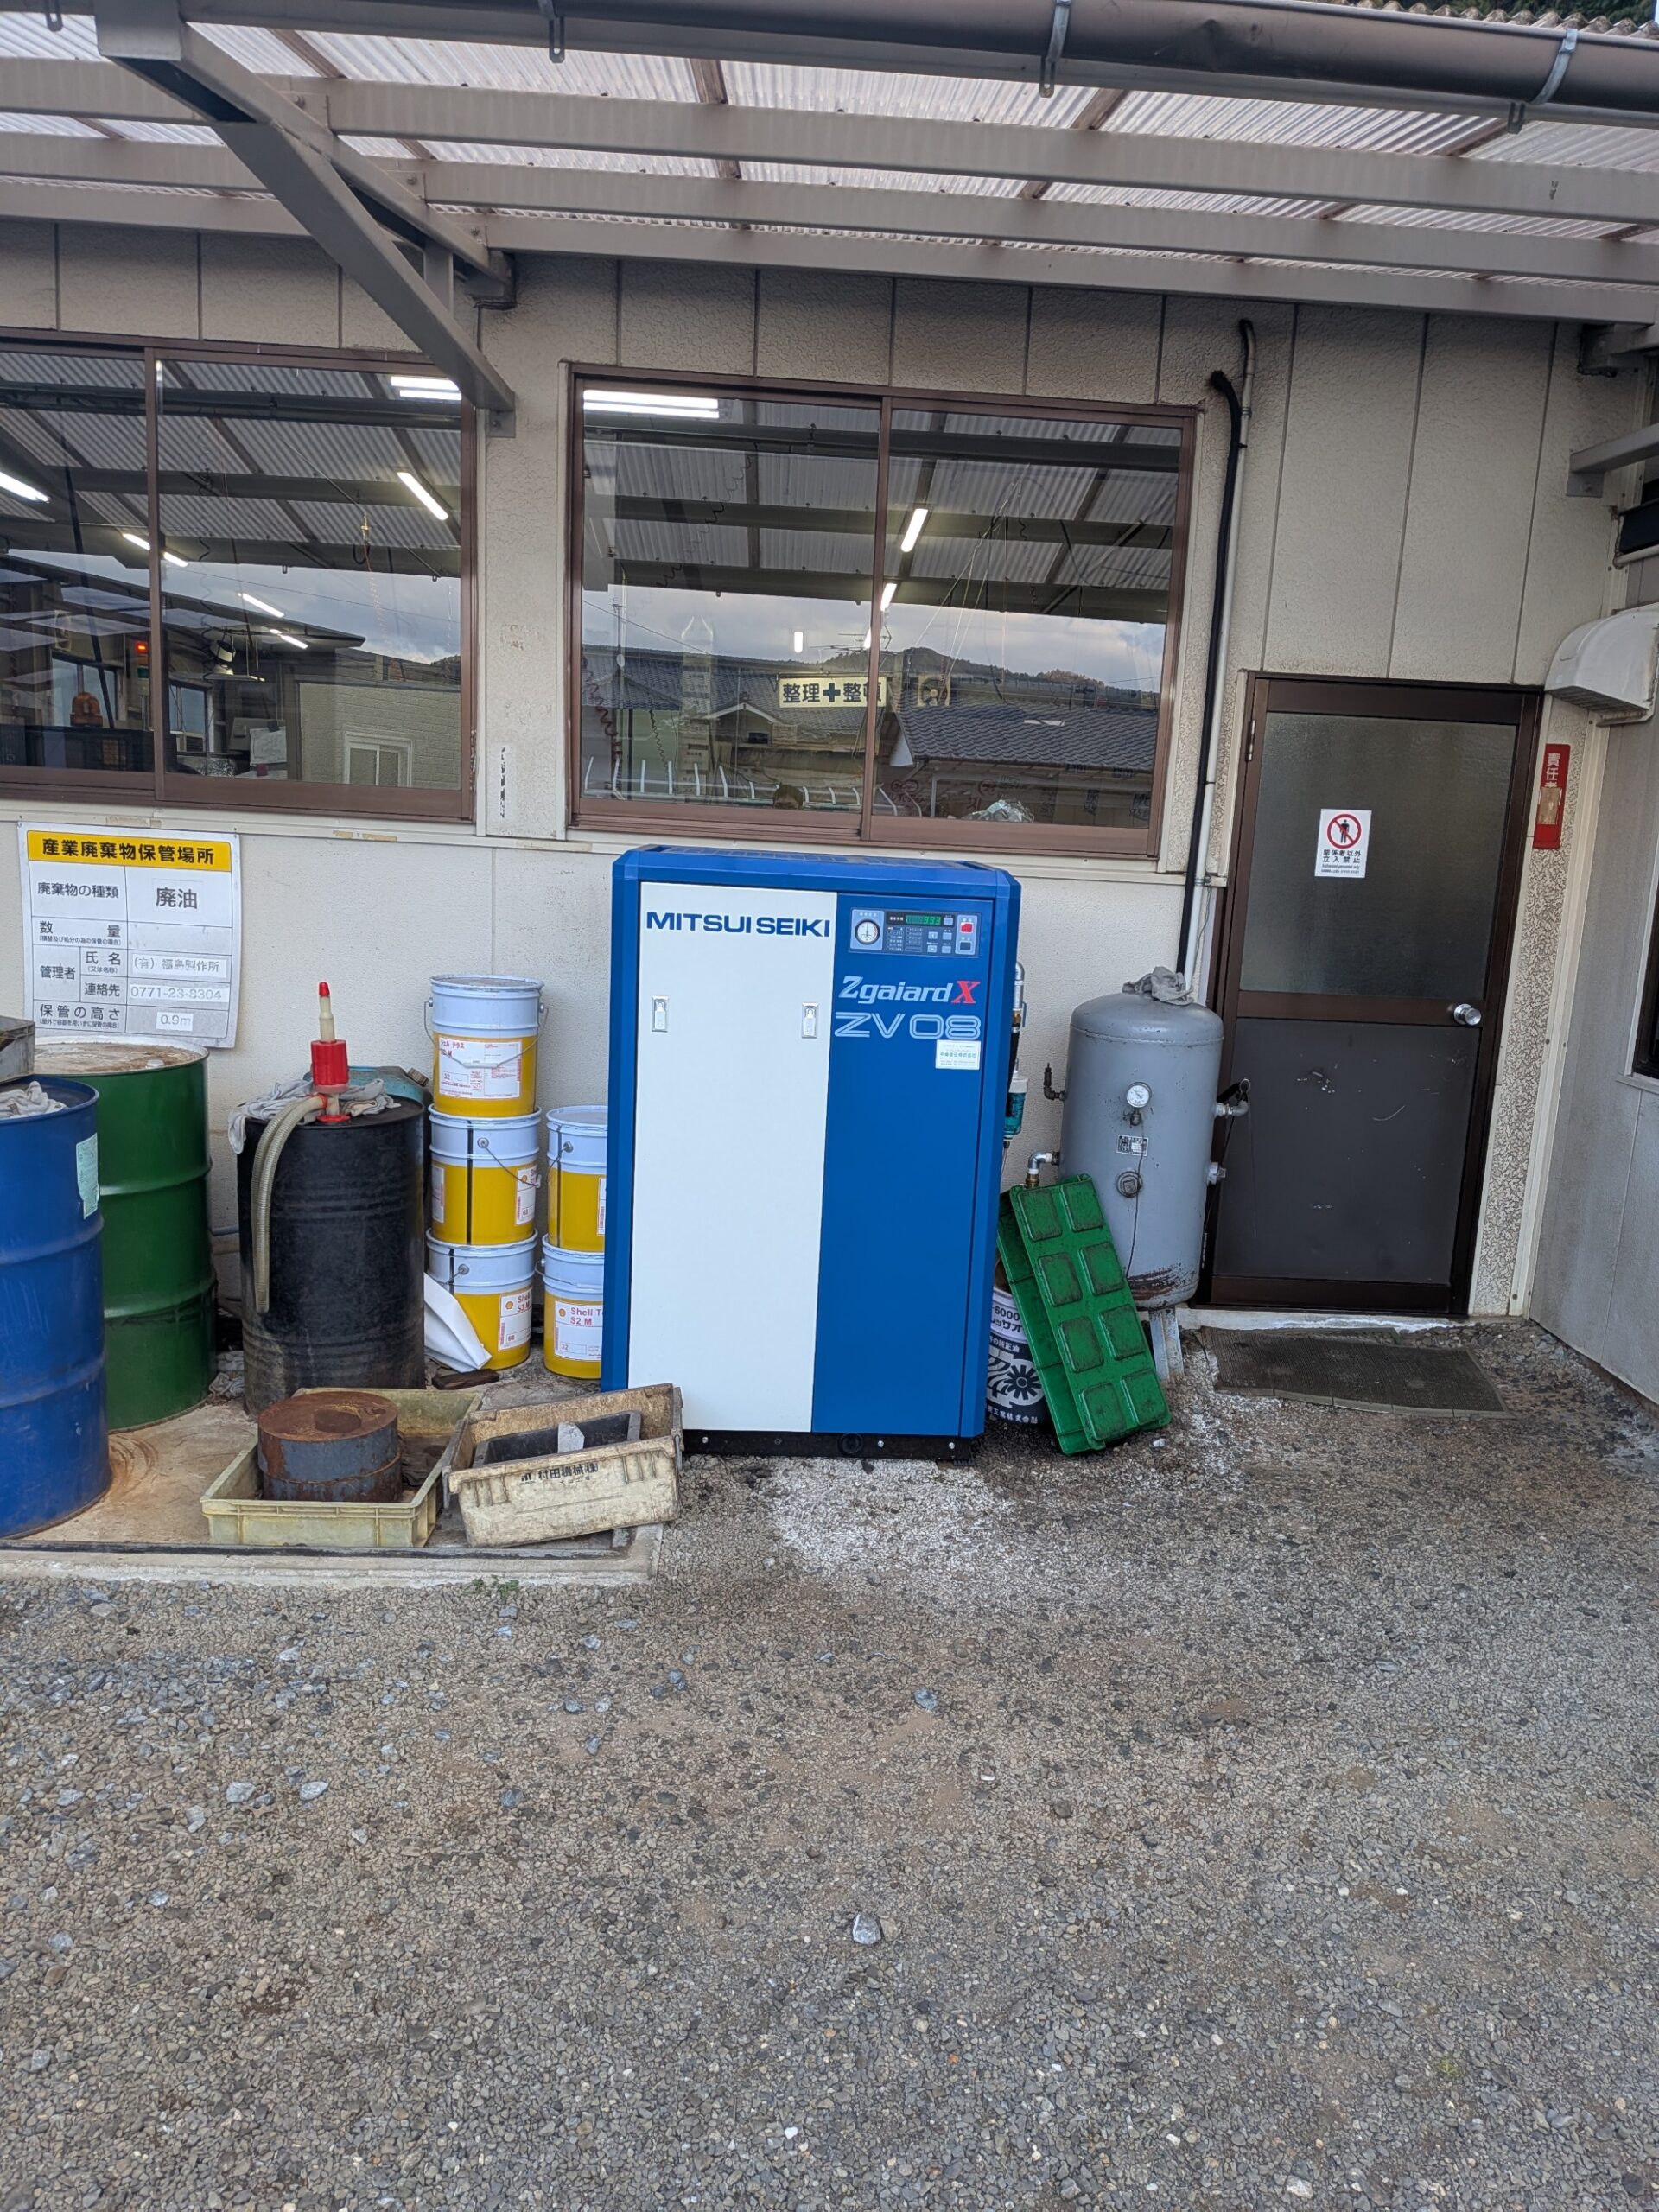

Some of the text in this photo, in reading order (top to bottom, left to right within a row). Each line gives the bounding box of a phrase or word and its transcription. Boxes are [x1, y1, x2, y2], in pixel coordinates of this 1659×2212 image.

[782, 682, 820, 703] 整理
[42, 838, 214, 865] 産業廃棄物保管場所
[1322, 855, 1361, 864] 立入禁止
[37, 881, 119, 899] 廃棄物の種類
[156, 887, 199, 910] 廃油
[646, 912, 831, 938] MITSUI SEIKI
[40, 964, 76, 980] 管理者
[84, 982, 121, 997] 連絡先
[40, 1003, 121, 1020] 保管の高さ
[570, 1307, 593, 1317] Shell
[570, 1317, 582, 1325] S2
